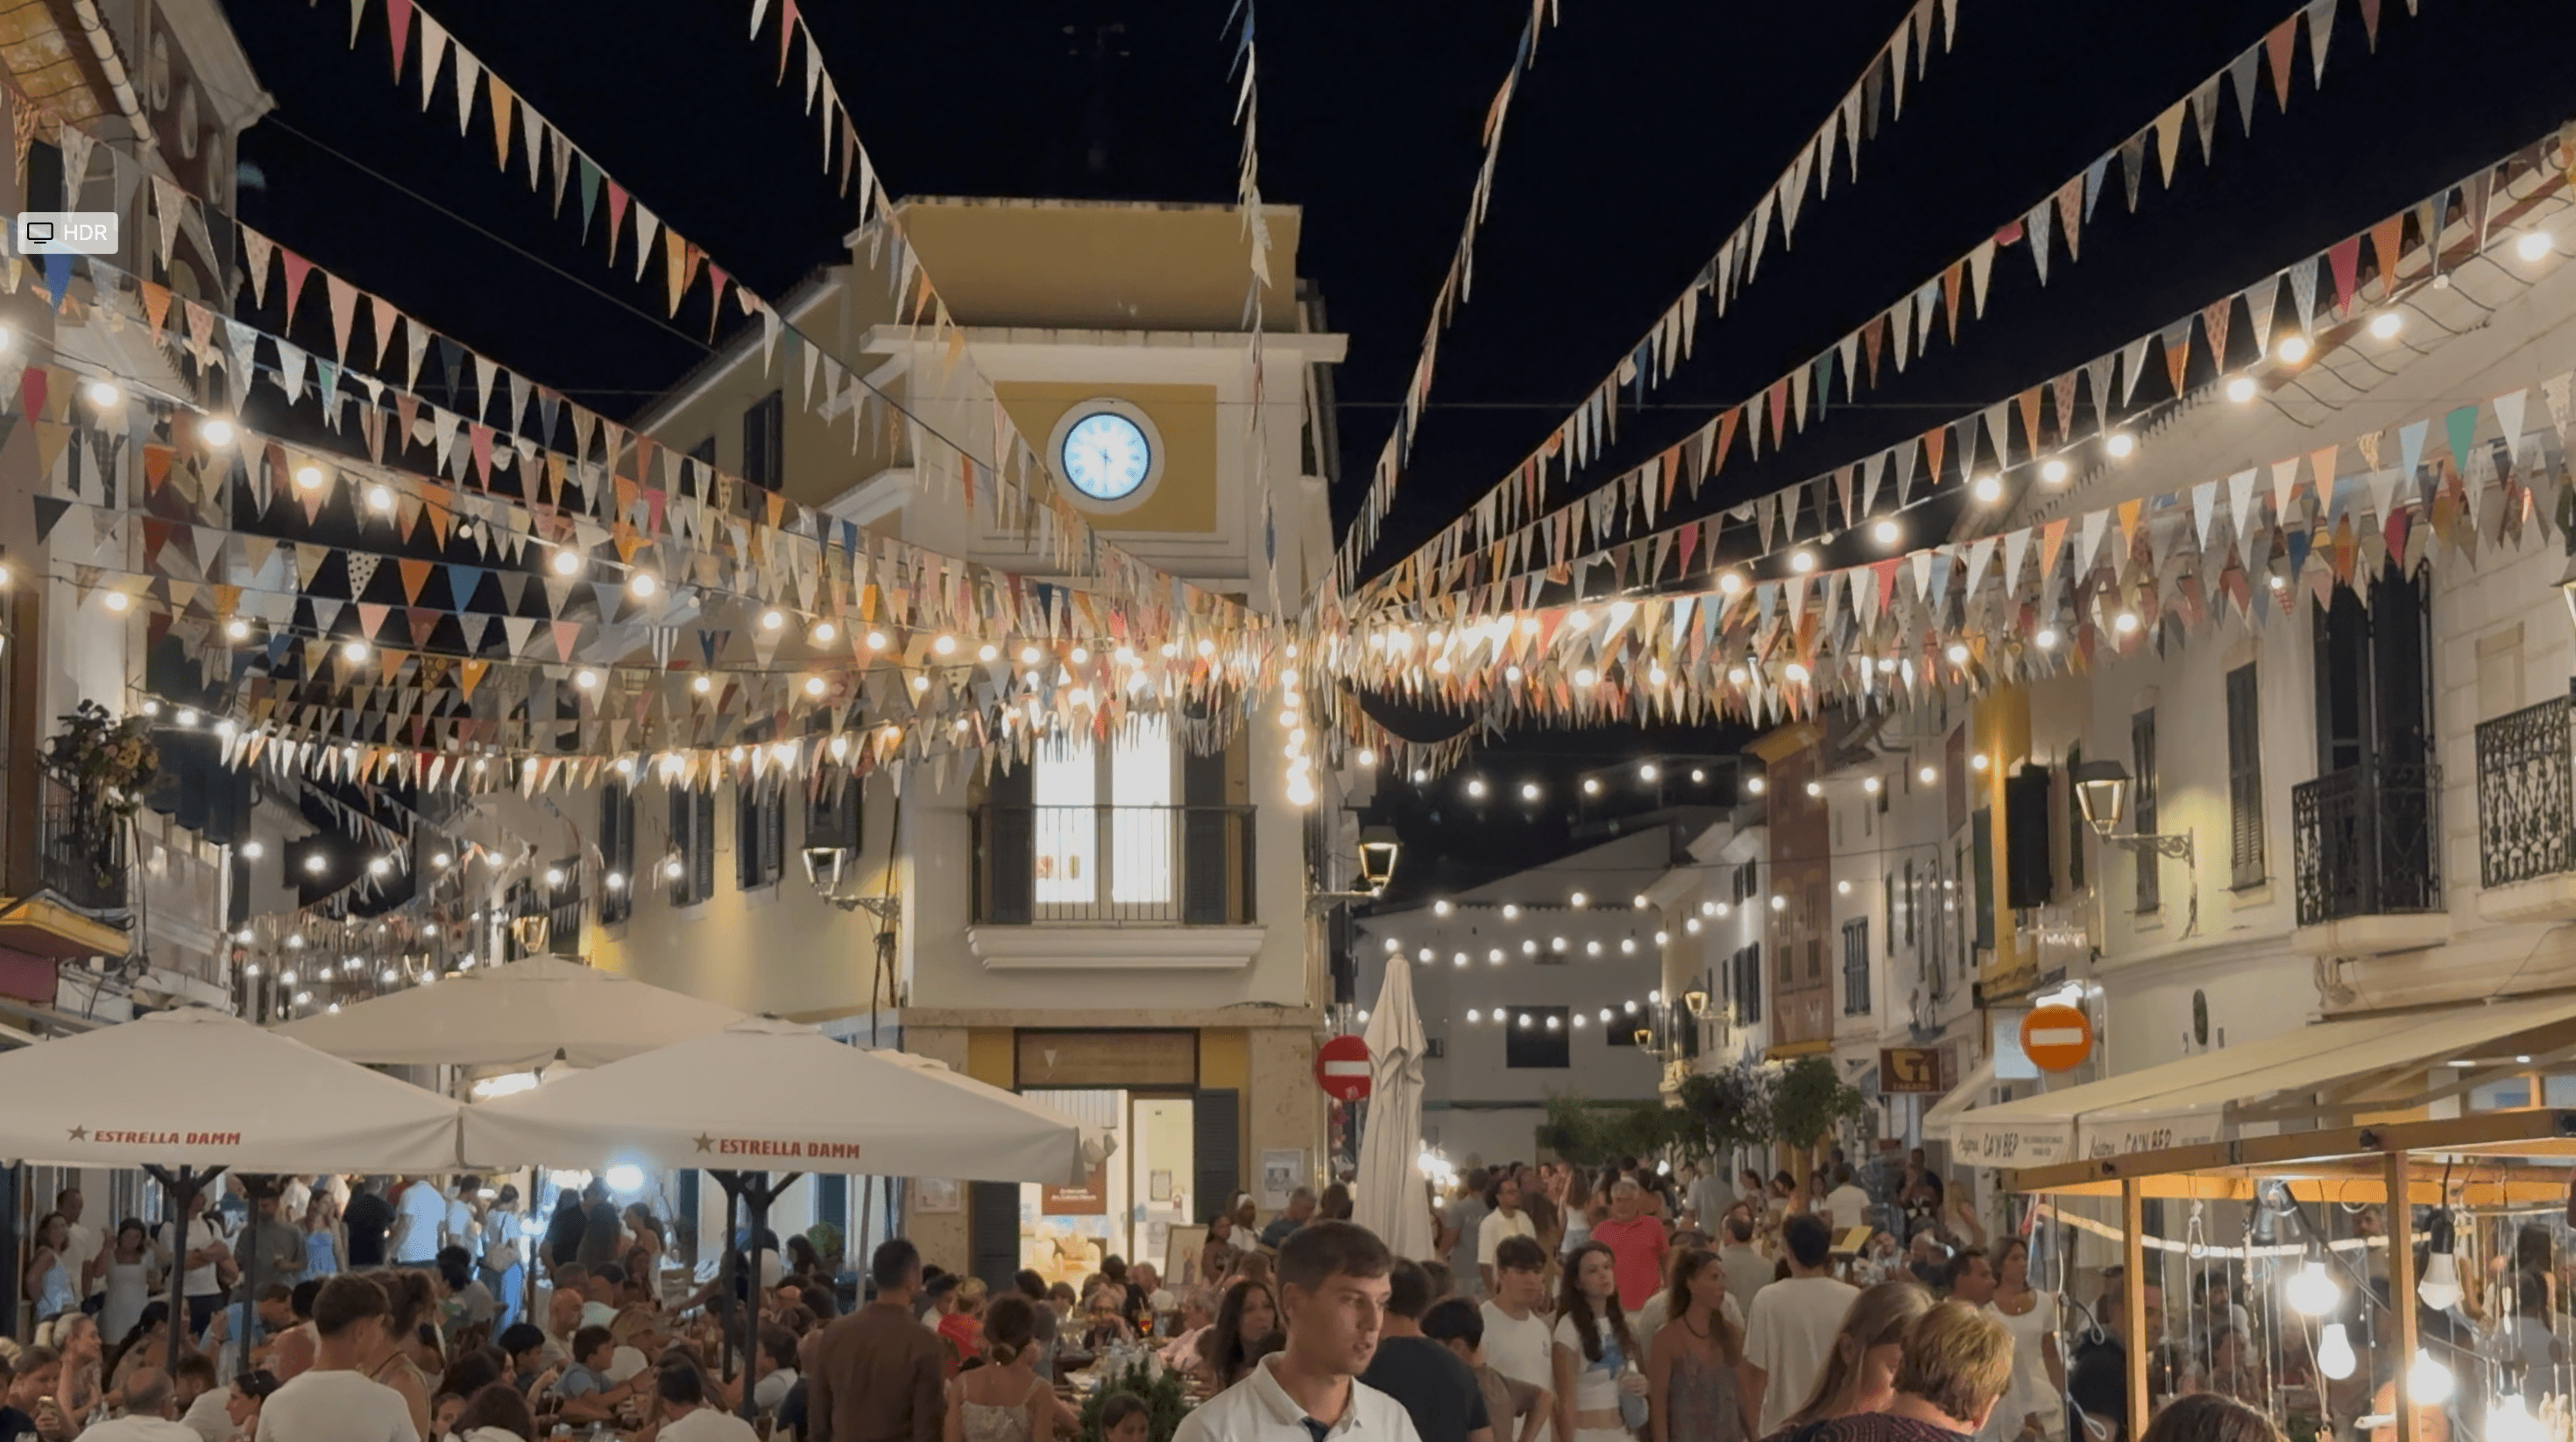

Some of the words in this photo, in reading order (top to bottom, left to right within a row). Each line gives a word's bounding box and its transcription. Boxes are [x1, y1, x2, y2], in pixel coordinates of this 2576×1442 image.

[94, 1129, 180, 1145] ESTRELLA
[185, 1132, 241, 1146] DAMM
[719, 1138, 802, 1157] ESTRELLA
[807, 1142, 860, 1159] DAMM
